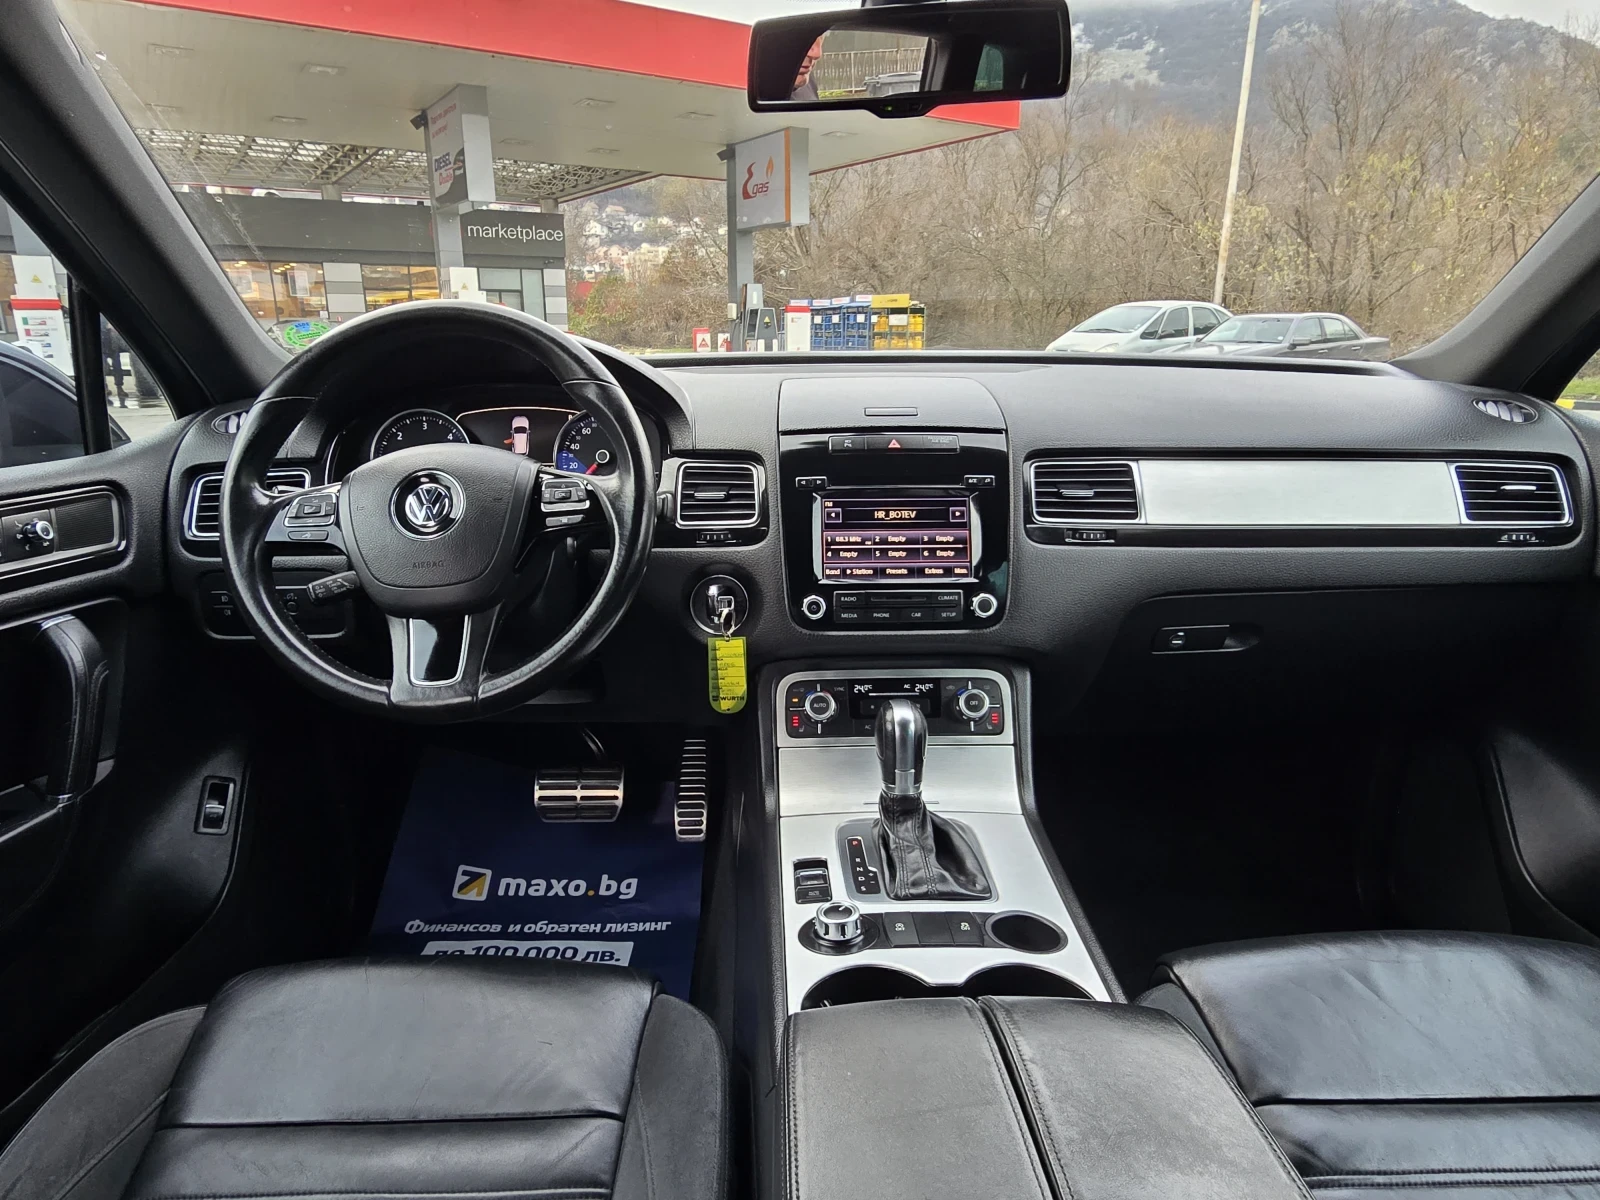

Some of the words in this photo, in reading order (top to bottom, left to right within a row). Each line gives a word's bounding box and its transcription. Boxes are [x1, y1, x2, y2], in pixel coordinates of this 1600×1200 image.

[467, 223, 564, 242] marketplace
[422, 422, 428, 430] 3
[581, 427, 591, 435] 60
[397, 432, 402, 440] 2
[447, 433, 453, 441] 4
[874, 510, 917, 520] HR_BOTEV
[887, 535, 907, 543] Empty
[935, 535, 955, 543] Empty
[888, 550, 907, 558] Empty
[412, 560, 444, 569] AIRBAG
[924, 567, 944, 575] Extras
[497, 874, 638, 900] maxo.bg
[404, 919, 503, 935] Финансов
[507, 923, 522, 933] и
[523, 920, 602, 935] обратен
[602, 921, 672, 933] лизинг
